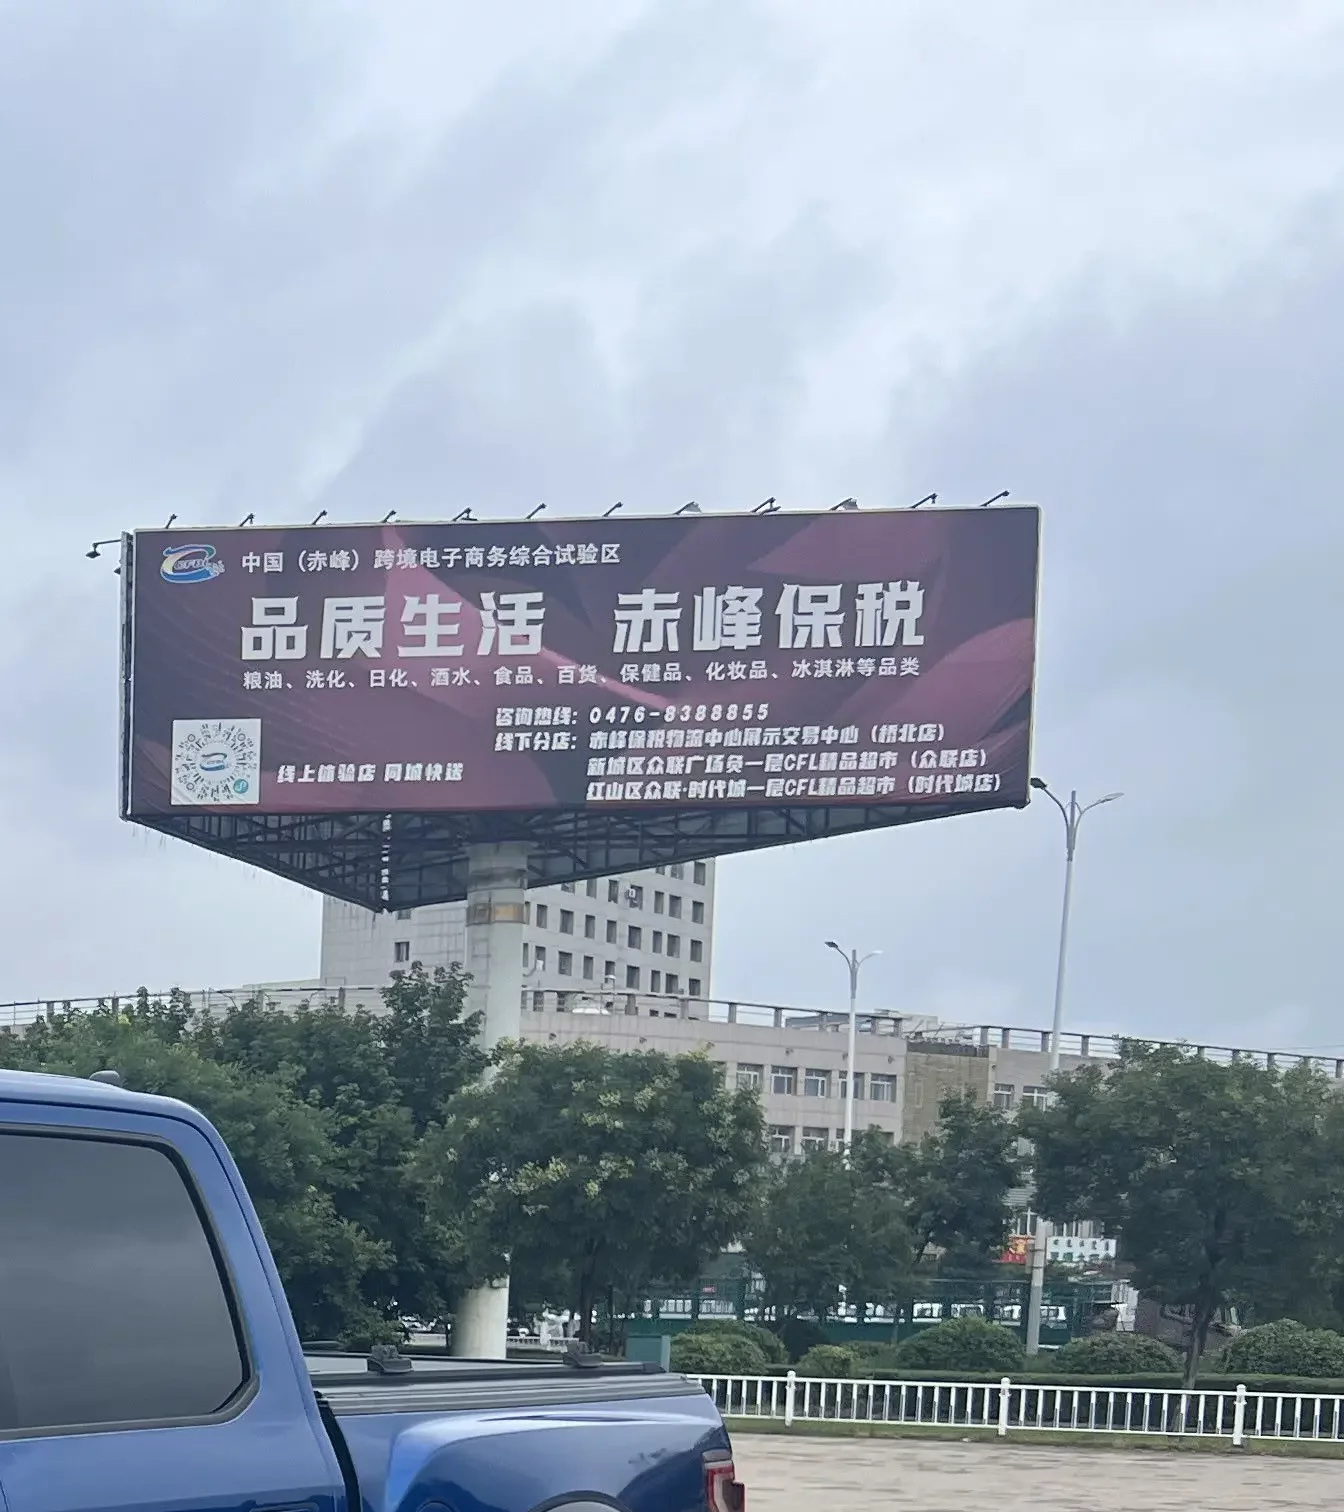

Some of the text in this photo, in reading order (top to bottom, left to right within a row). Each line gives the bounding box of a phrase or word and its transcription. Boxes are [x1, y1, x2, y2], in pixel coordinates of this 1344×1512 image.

[241, 579, 926, 661] 品质生活 赤峰保税
[276, 762, 464, 784] 线上体验店 同城快送
